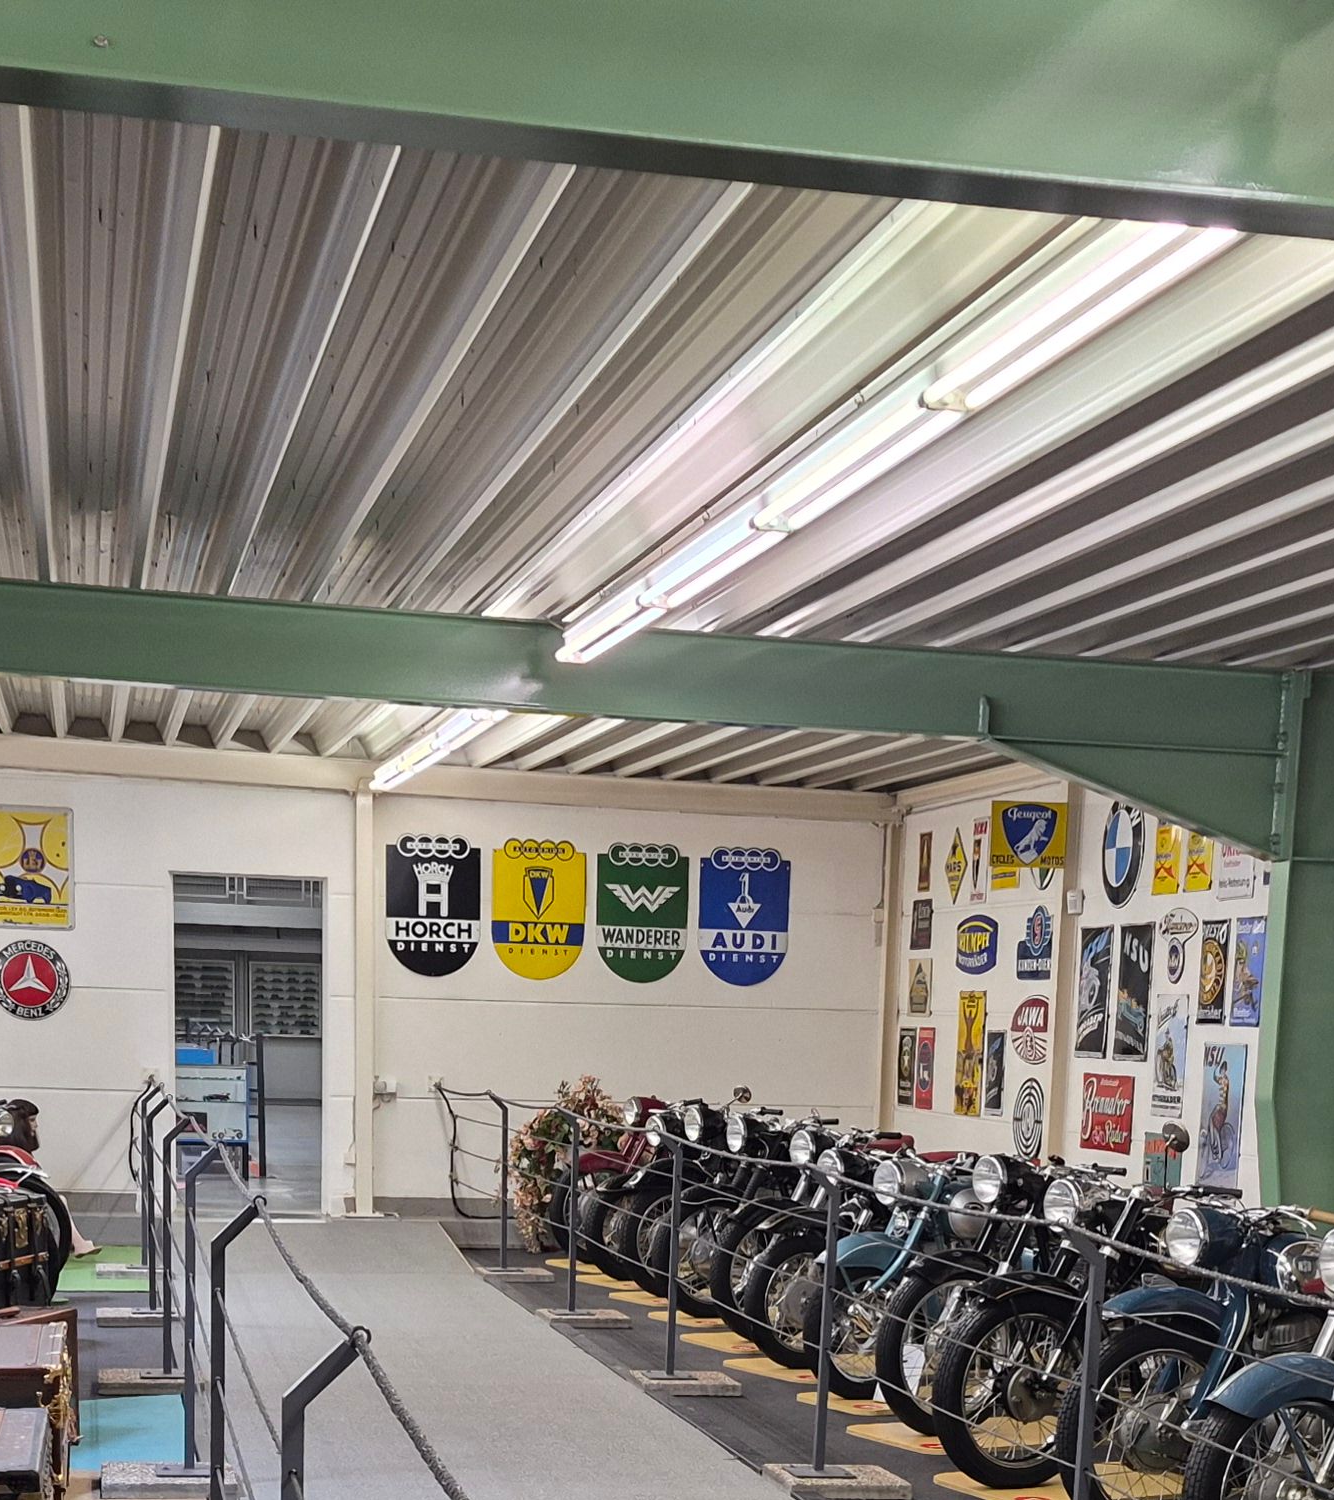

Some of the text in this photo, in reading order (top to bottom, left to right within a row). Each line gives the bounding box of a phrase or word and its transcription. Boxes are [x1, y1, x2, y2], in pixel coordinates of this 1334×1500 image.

[1007, 807, 1053, 821] Peugeot
[1040, 854, 1065, 866] MOTOS
[413, 861, 454, 877] HORCH
[529, 869, 550, 879] DKW
[395, 920, 472, 939] HORCH
[508, 922, 570, 944] DKW
[601, 927, 682, 947] WANDERER
[396, 941, 471, 954] DIENST
[711, 931, 778, 951] AUDI
[1, 941, 56, 960] MERCEDES
[508, 946, 570, 957] DIENST
[606, 949, 678, 961] DIENST
[708, 953, 779, 963] DIENST
[1123, 930, 1149, 973] NSU
[15, 1006, 45, 1018] BENZ
[1017, 1006, 1045, 1027] JAWA
